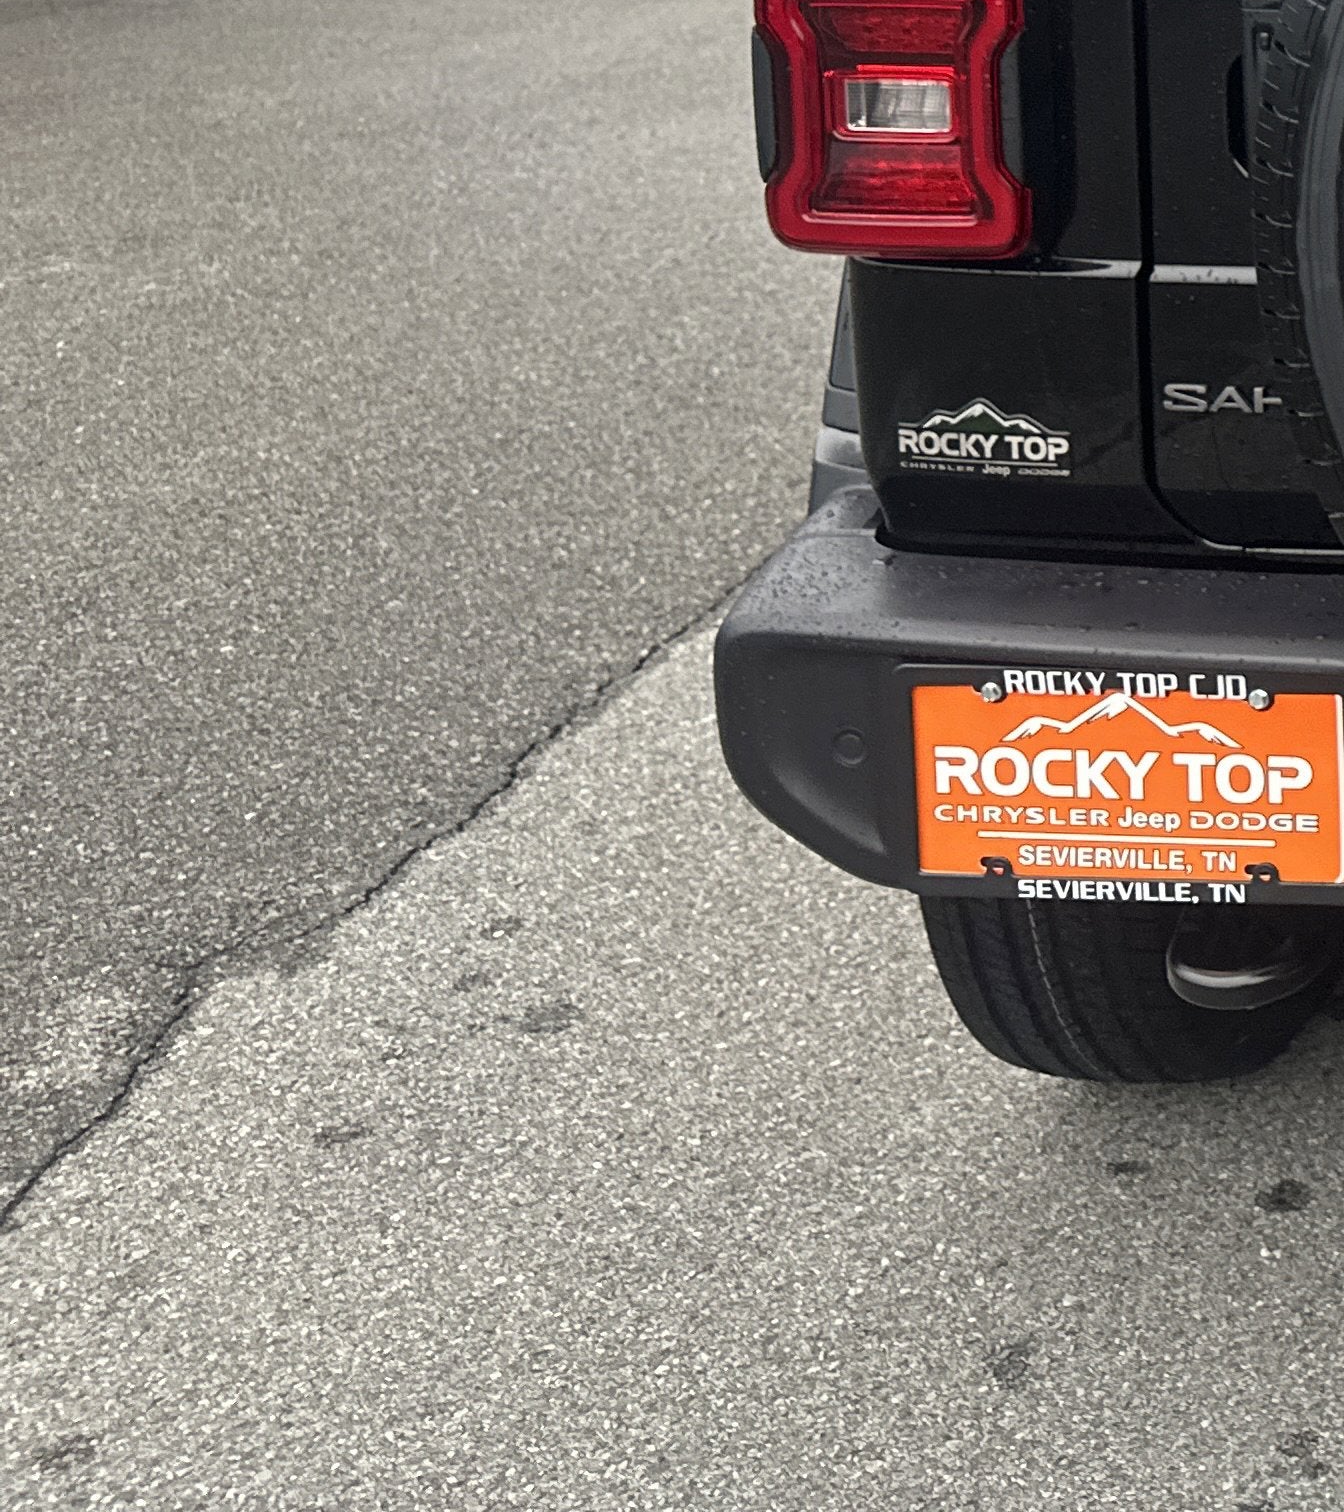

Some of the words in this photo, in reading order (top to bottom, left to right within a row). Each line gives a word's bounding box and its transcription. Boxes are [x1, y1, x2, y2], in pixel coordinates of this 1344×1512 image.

[898, 429, 999, 459] ROCKY
[1004, 435, 1070, 461] TOP
[982, 463, 1011, 477] Jeep
[1003, 670, 1105, 696] ROCKY
[1117, 672, 1178, 699] TOP
[1190, 674, 1247, 702] CJD
[934, 746, 1160, 800] ROCKY
[1172, 752, 1313, 804] TOP
[934, 804, 1110, 827] CHRYSLER
[1117, 805, 1181, 831] Jeep
[1190, 811, 1319, 832] DODGE
[1018, 845, 1193, 874] SEVIERVILLE,
[1202, 850, 1237, 872] TN
[1018, 879, 1199, 904] SEVIERVILLE,
[1208, 883, 1245, 904] TN
